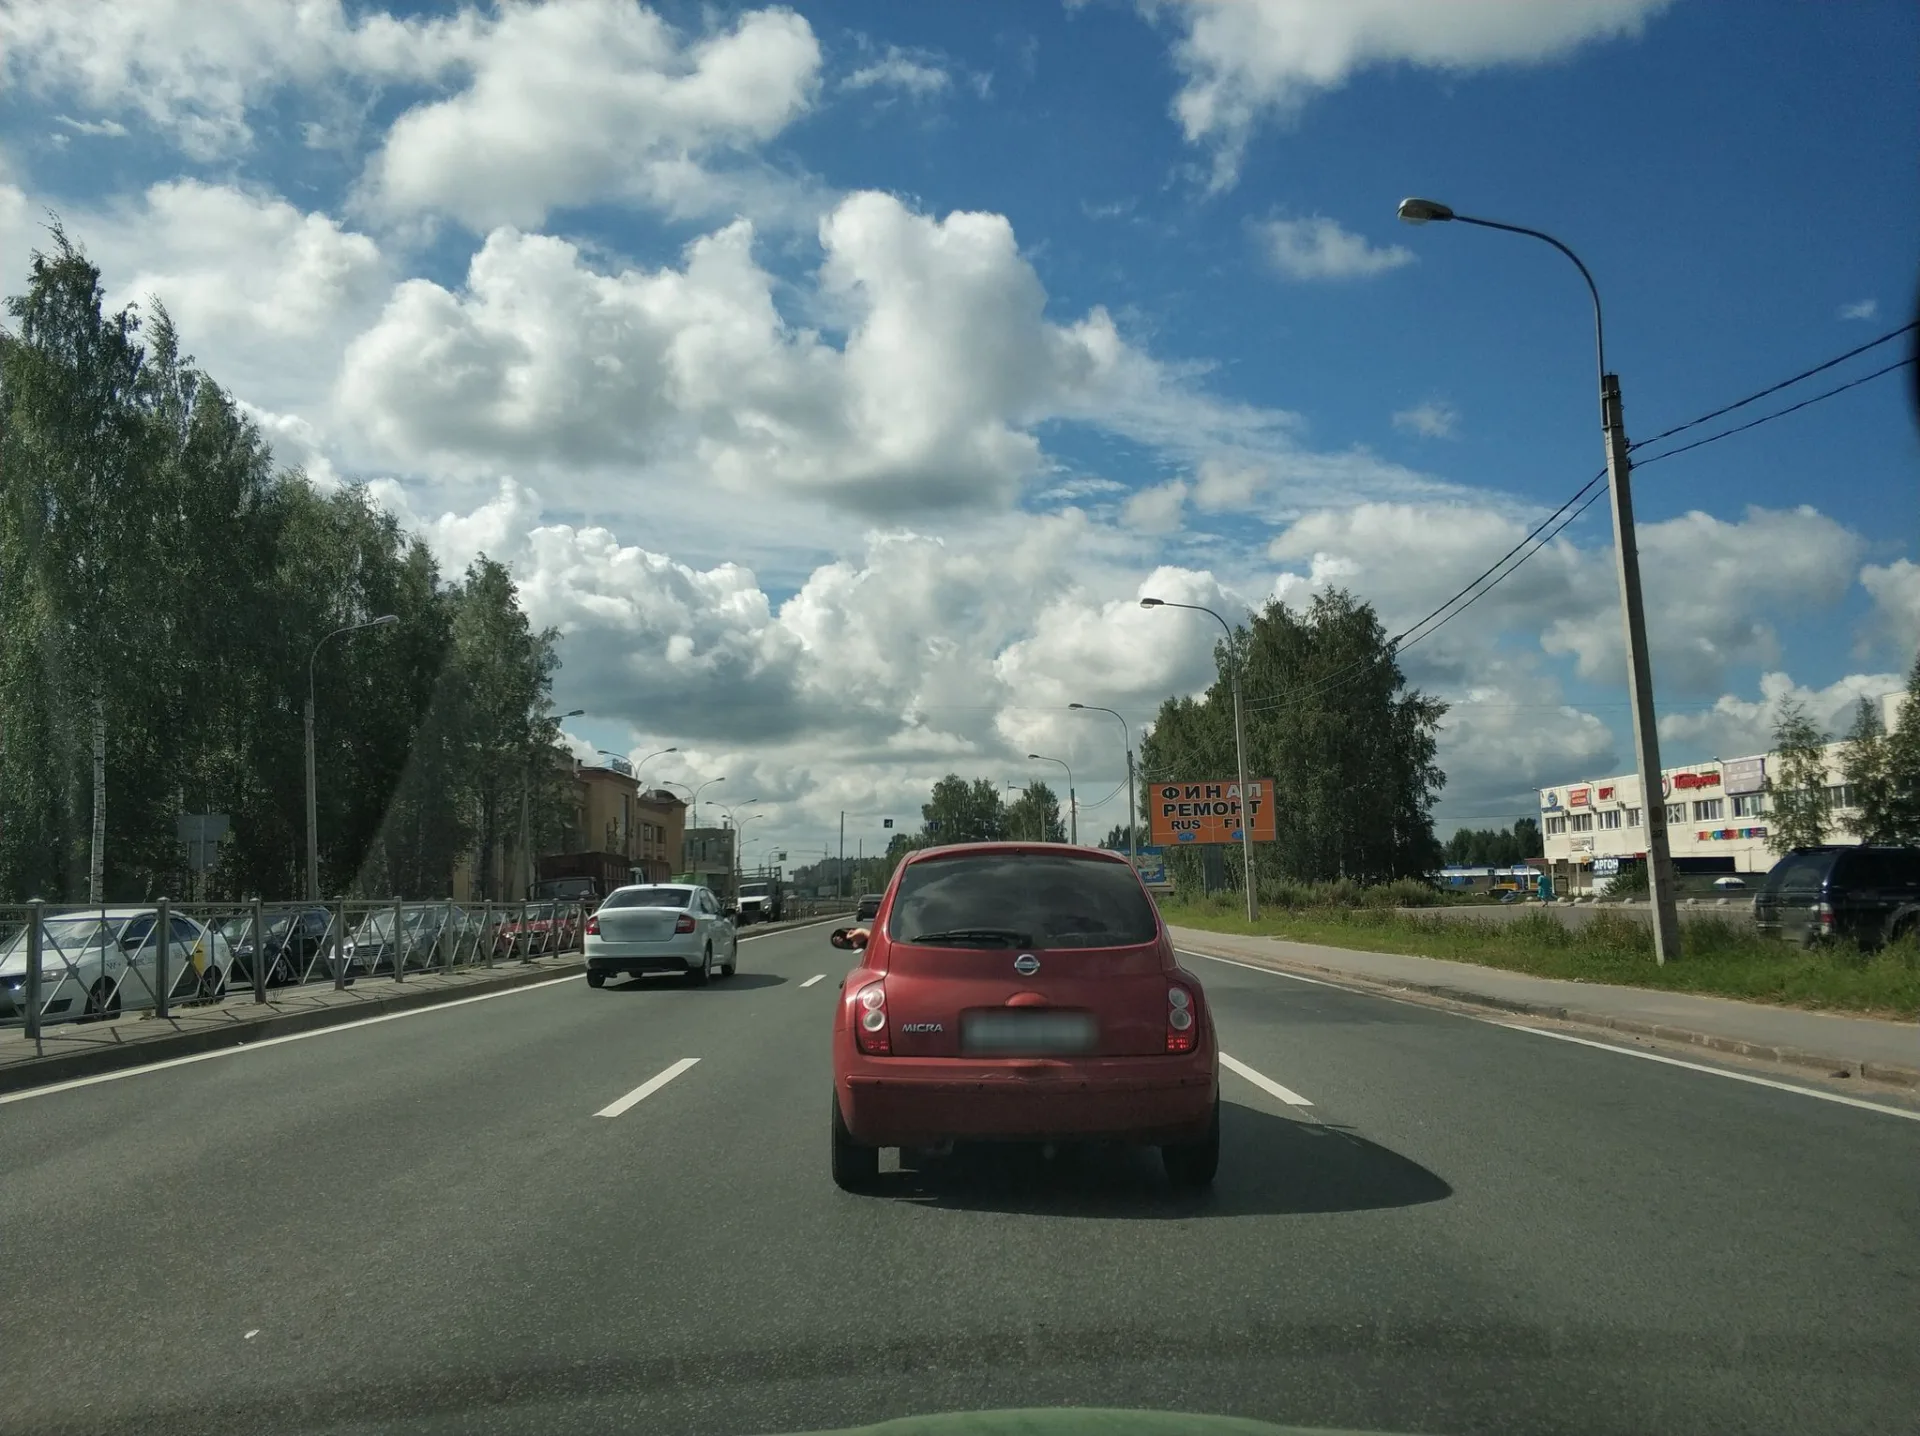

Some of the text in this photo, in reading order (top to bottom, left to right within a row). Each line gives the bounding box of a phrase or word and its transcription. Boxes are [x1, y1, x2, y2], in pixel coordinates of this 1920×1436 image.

[1171, 820, 1200, 830] RUS
[1593, 859, 1619, 870] АРГОН
[902, 1023, 943, 1032] MICRA
